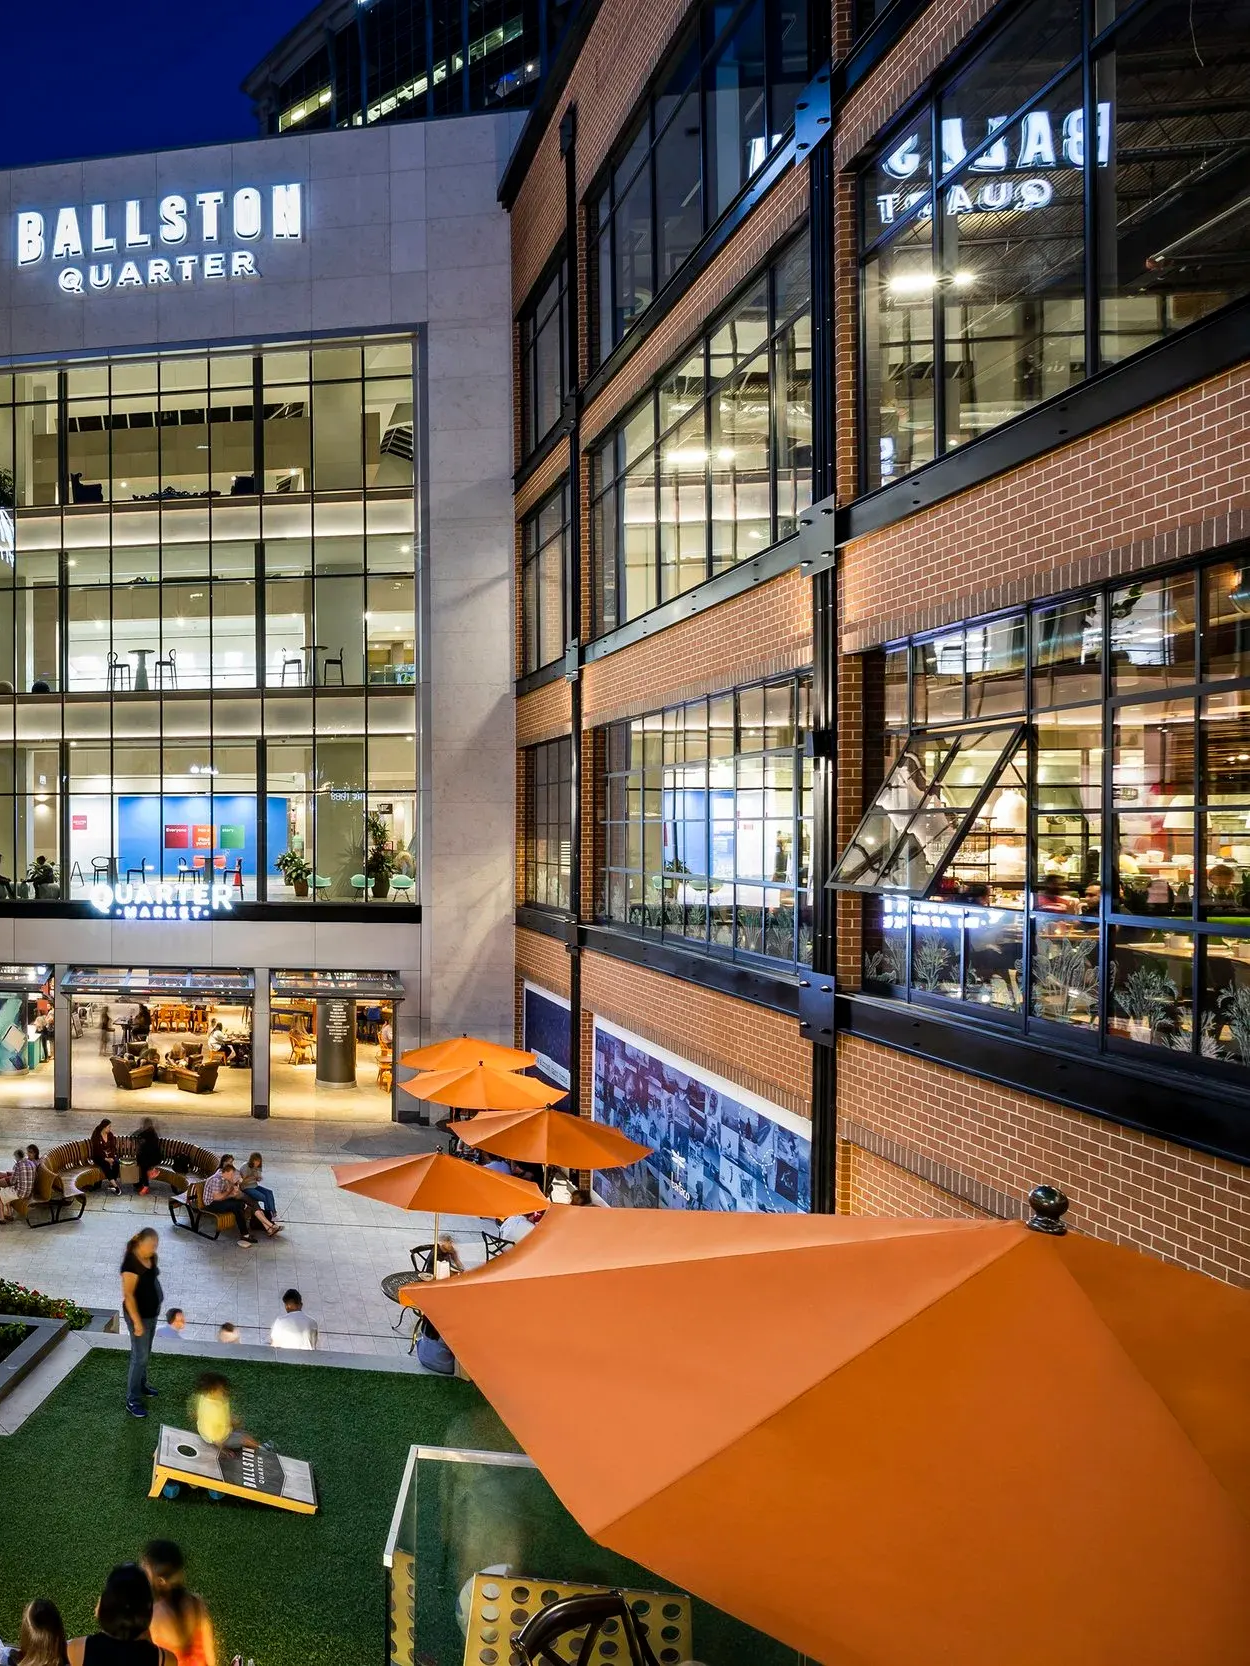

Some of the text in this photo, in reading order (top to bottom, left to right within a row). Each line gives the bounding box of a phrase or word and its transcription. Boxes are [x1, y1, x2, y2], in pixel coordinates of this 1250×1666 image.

[17, 183, 302, 267] BALLSTON
[58, 251, 258, 294] QUARTER
[90, 882, 233, 914] QUARTER
[124, 905, 202, 919] MARKET
